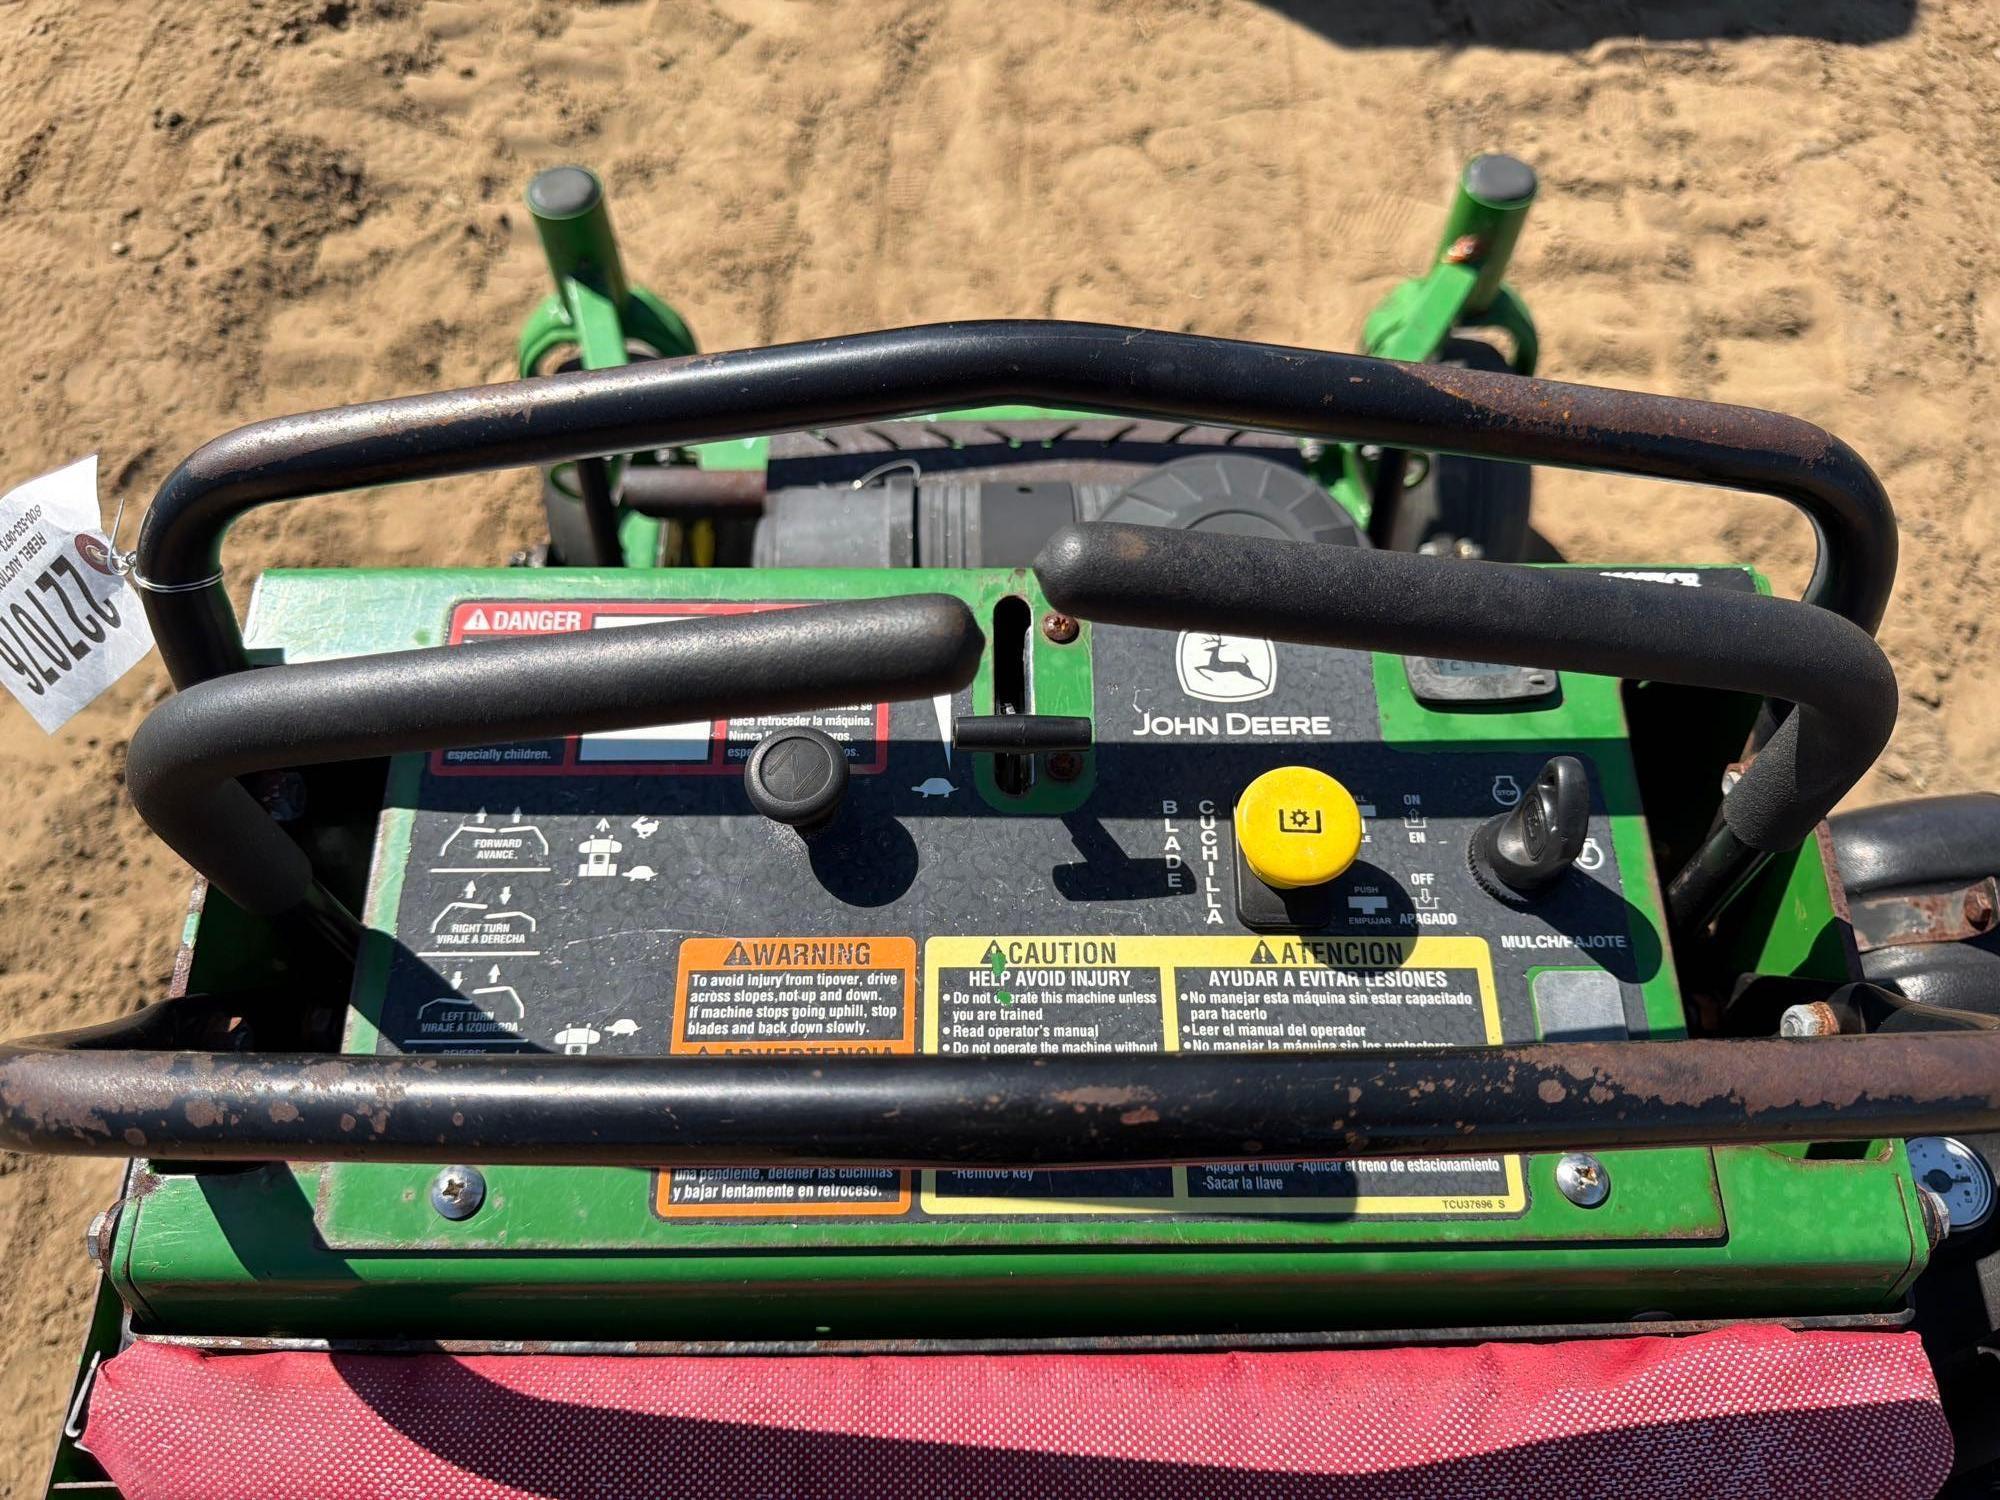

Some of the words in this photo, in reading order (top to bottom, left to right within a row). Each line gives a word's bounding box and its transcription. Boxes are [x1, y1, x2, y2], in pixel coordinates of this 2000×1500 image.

[18, 531, 48, 562] REBEL
[0, 554, 122, 696] 227076
[493, 611, 581, 631] DANGER
[758, 716, 810, 726] retroceder
[813, 714, 822, 726] la
[824, 714, 874, 728] máquina.
[1132, 713, 1218, 736] JOHN
[1226, 713, 1332, 736] DEERE
[447, 749, 502, 762] especially
[504, 748, 552, 760] children.
[1404, 794, 1420, 805] ON
[474, 838, 522, 849] FORWARD
[1162, 800, 1182, 888] BLADE
[1409, 832, 1426, 844] EN
[1199, 800, 1224, 924] CUCHILLA
[1411, 874, 1434, 885] OFF
[1348, 916, 1392, 924] EMPUJAR
[1400, 913, 1458, 924] APAGADO
[452, 924, 482, 934] RIGHT
[484, 924, 510, 934] TURN
[437, 934, 470, 944] VIRAJE
[470, 934, 480, 944] A
[480, 934, 525, 944] DERECHA
[1502, 934, 1626, 950] MULCH/PAJOTE
[753, 942, 870, 966] WARNING
[1009, 942, 1116, 964] CAUTION
[1282, 942, 1403, 966] ATENCION
[692, 974, 706, 987] To
[710, 974, 744, 987] avoid
[748, 974, 781, 990] injury
[785, 974, 814, 986] from
[816, 973, 863, 988] tipover,
[867, 973, 898, 986] drive
[969, 970, 1011, 986] HELP
[1015, 970, 1066, 986] AVOID
[1071, 970, 1131, 986] INJURY
[1209, 970, 1278, 987] AYUDAR
[1284, 971, 1296, 986] A
[1300, 970, 1358, 986] EVITAR
[1365, 971, 1448, 987] LESIONES
[690, 991, 731, 1003] across
[734, 990, 778, 1004] slopes,
[778, 990, 799, 1002] not
[801, 992, 816, 1004] up
[820, 989, 842, 1002] and
[846, 989, 882, 1002] down.
[954, 992, 970, 1004] Do
[973, 992, 991, 1004] not
[994, 992, 1038, 1006] oerate
[1040, 992, 1063, 1004] this
[1066, 992, 1116, 1004] machine
[1118, 992, 1157, 1004] unless
[1190, 991, 1206, 1004] No
[1210, 992, 1261, 1007] manejar
[1264, 992, 1288, 1004] esta
[1292, 990, 1346, 1008] máquina
[1349, 992, 1368, 1004] sin
[1371, 992, 1402, 1005] estar
[1406, 992, 1472, 1008] capacitado
[441, 1011, 464, 1022] LEFT
[466, 1011, 494, 1021] TURN
[689, 1006, 700, 1018] If
[702, 1006, 754, 1018] machine
[756, 1006, 788, 1021] stops
[792, 1006, 826, 1020] going
[829, 1005, 868, 1020] uphill,
[871, 1005, 897, 1020] stop
[952, 1009, 973, 1022] you
[977, 1009, 996, 1020] are
[1000, 1008, 1043, 1020] trained
[1190, 1010, 1218, 1023] para
[1221, 1008, 1268, 1020] hacerlo
[422, 1022, 454, 1032] VIRAJE
[455, 1022, 464, 1032] A
[466, 1022, 518, 1032] IZQUIERDA
[688, 1022, 728, 1035] blades
[732, 1021, 754, 1034] and
[758, 1021, 787, 1034] back
[790, 1021, 823, 1034] down
[826, 1020, 870, 1036] slowly.
[954, 1025, 984, 1038] Read
[988, 1025, 1050, 1040] operator's
[1054, 1024, 1099, 1038] manual
[1192, 1024, 1220, 1036] Leer
[1222, 1024, 1234, 1036] el
[1238, 1024, 1284, 1036] manual
[1288, 1024, 1308, 1036] del
[1310, 1024, 1366, 1038] operador
[954, 1042, 970, 1053] Do
[973, 1042, 991, 1054] not
[994, 1043, 1037, 1054] operate
[1040, 1042, 1060, 1053] the
[1062, 1042, 1112, 1052] machine
[1194, 1040, 1209, 1051] No
[1268, 1040, 1280, 1050] la
[1358, 1159, 1388, 1172] freno
[1390, 1158, 1404, 1171] de
[1406, 1158, 1500, 1172] estacionamiento
[768, 1168, 814, 1180] detener
[1012, 1169, 1034, 1182] key
[1202, 1176, 1238, 1189] -Sacar
[1242, 1176, 1252, 1188] la
[1256, 1176, 1283, 1188] llave
[673, 1187, 682, 1201] y
[684, 1184, 718, 1202] bajar
[722, 1184, 794, 1198] lentamente
[798, 1187, 814, 1198] en
[818, 1184, 883, 1198] retroceso.
[1444, 1200, 1492, 1209] TCU37696
